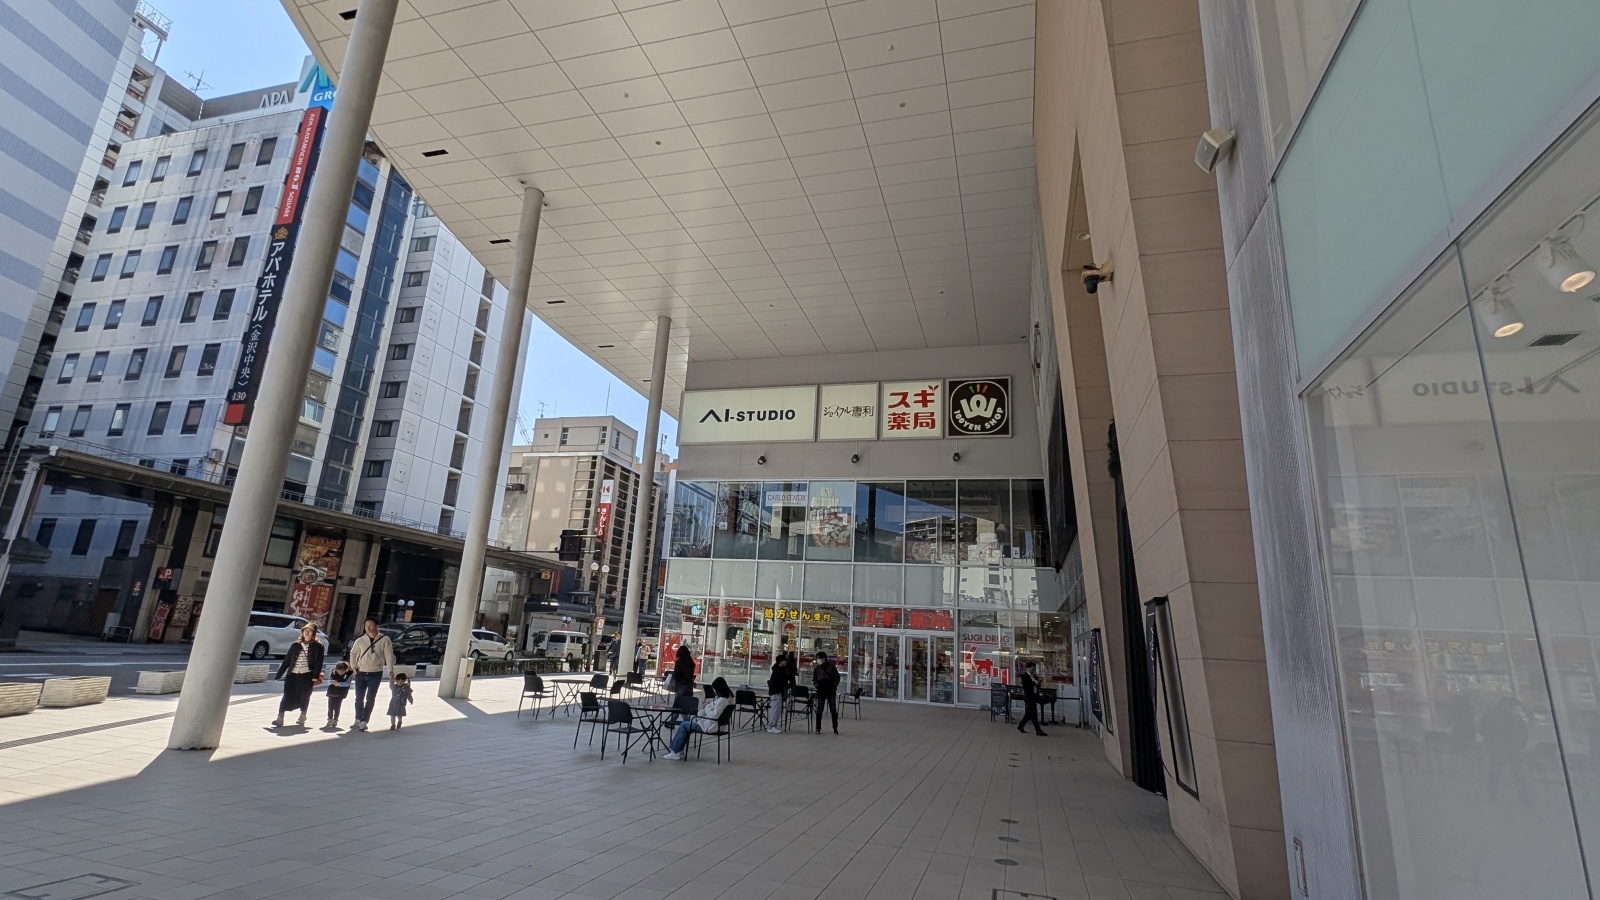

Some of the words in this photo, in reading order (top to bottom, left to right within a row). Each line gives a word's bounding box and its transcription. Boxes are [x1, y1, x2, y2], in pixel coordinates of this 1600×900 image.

[259, 90, 291, 109] APA
[313, 91, 336, 102] GR
[283, 191, 295, 218] SQUARE
[888, 385, 939, 408] スギ
[698, 408, 796, 423] AI-STUDIO
[887, 412, 936, 431] 薬局
[953, 409, 981, 431] 100YEN
[984, 407, 1004, 430] SHOP
[962, 633, 983, 642] SUGI
[985, 634, 1010, 643] DRUG
